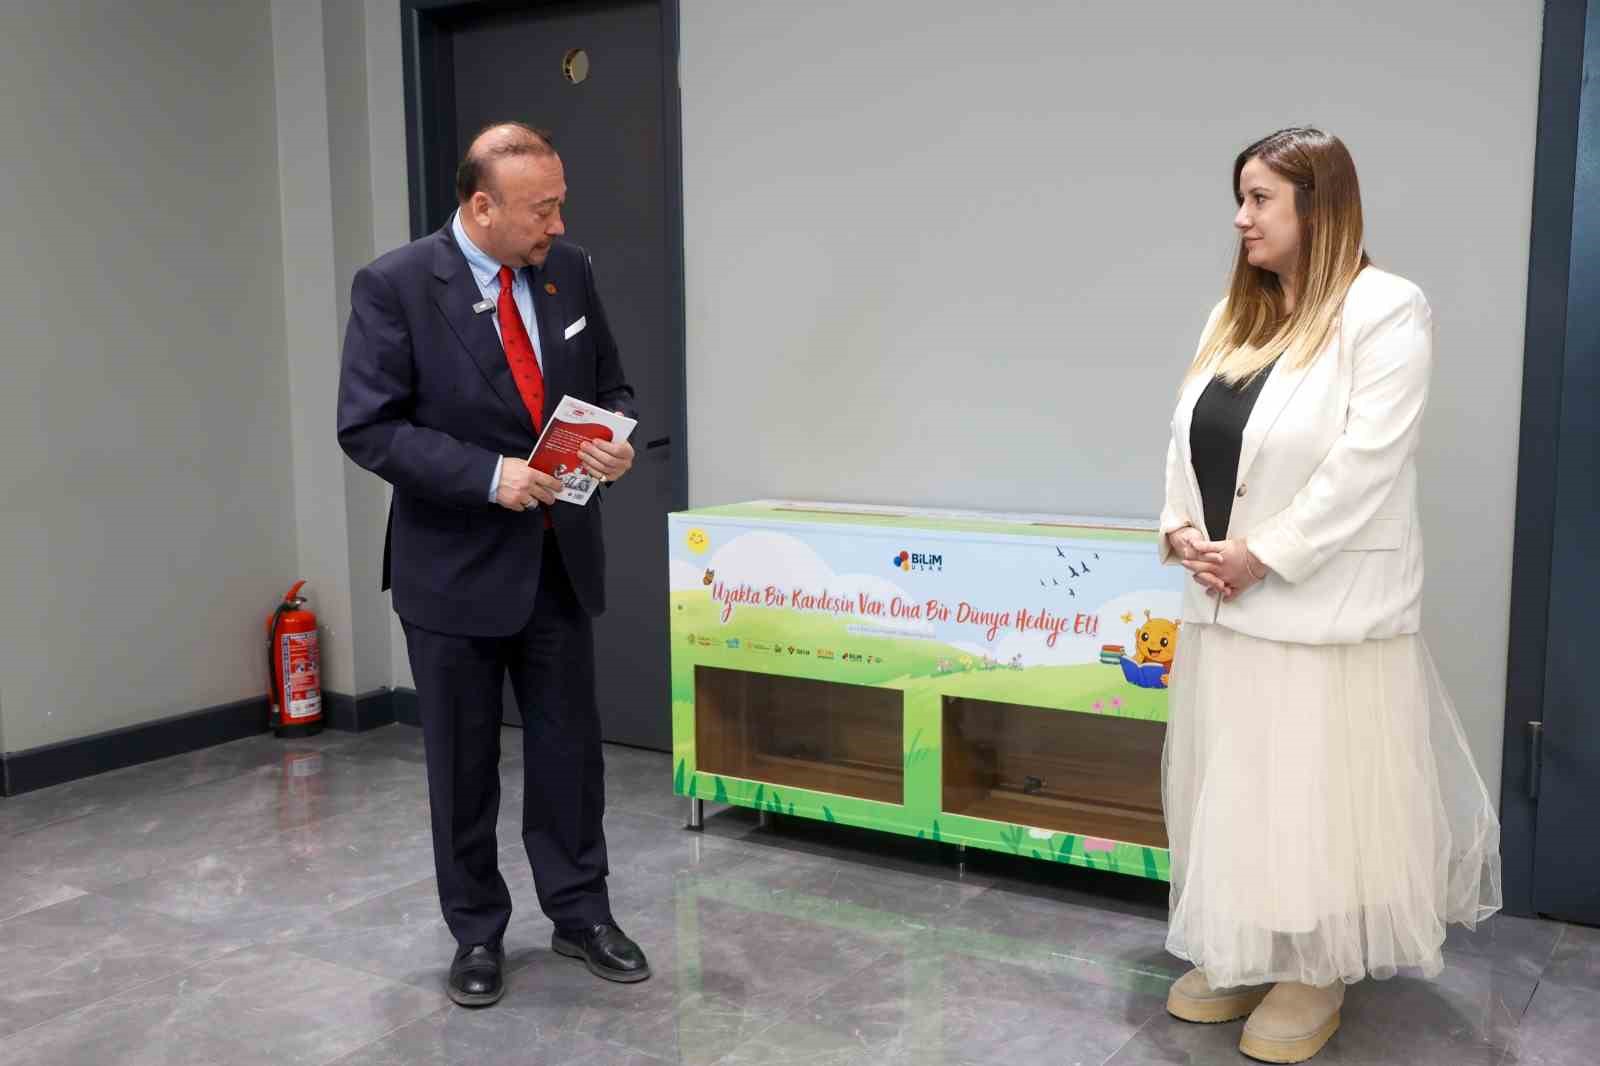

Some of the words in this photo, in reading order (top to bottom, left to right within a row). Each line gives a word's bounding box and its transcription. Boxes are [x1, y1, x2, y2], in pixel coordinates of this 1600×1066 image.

[712, 582, 761, 623] Uzakta
[764, 585, 787, 607] Bir
[890, 597, 921, 619] Ona
[926, 599, 950, 621] Bir
[1015, 607, 1069, 648] Hediye
[1073, 613, 1099, 637] Et!
